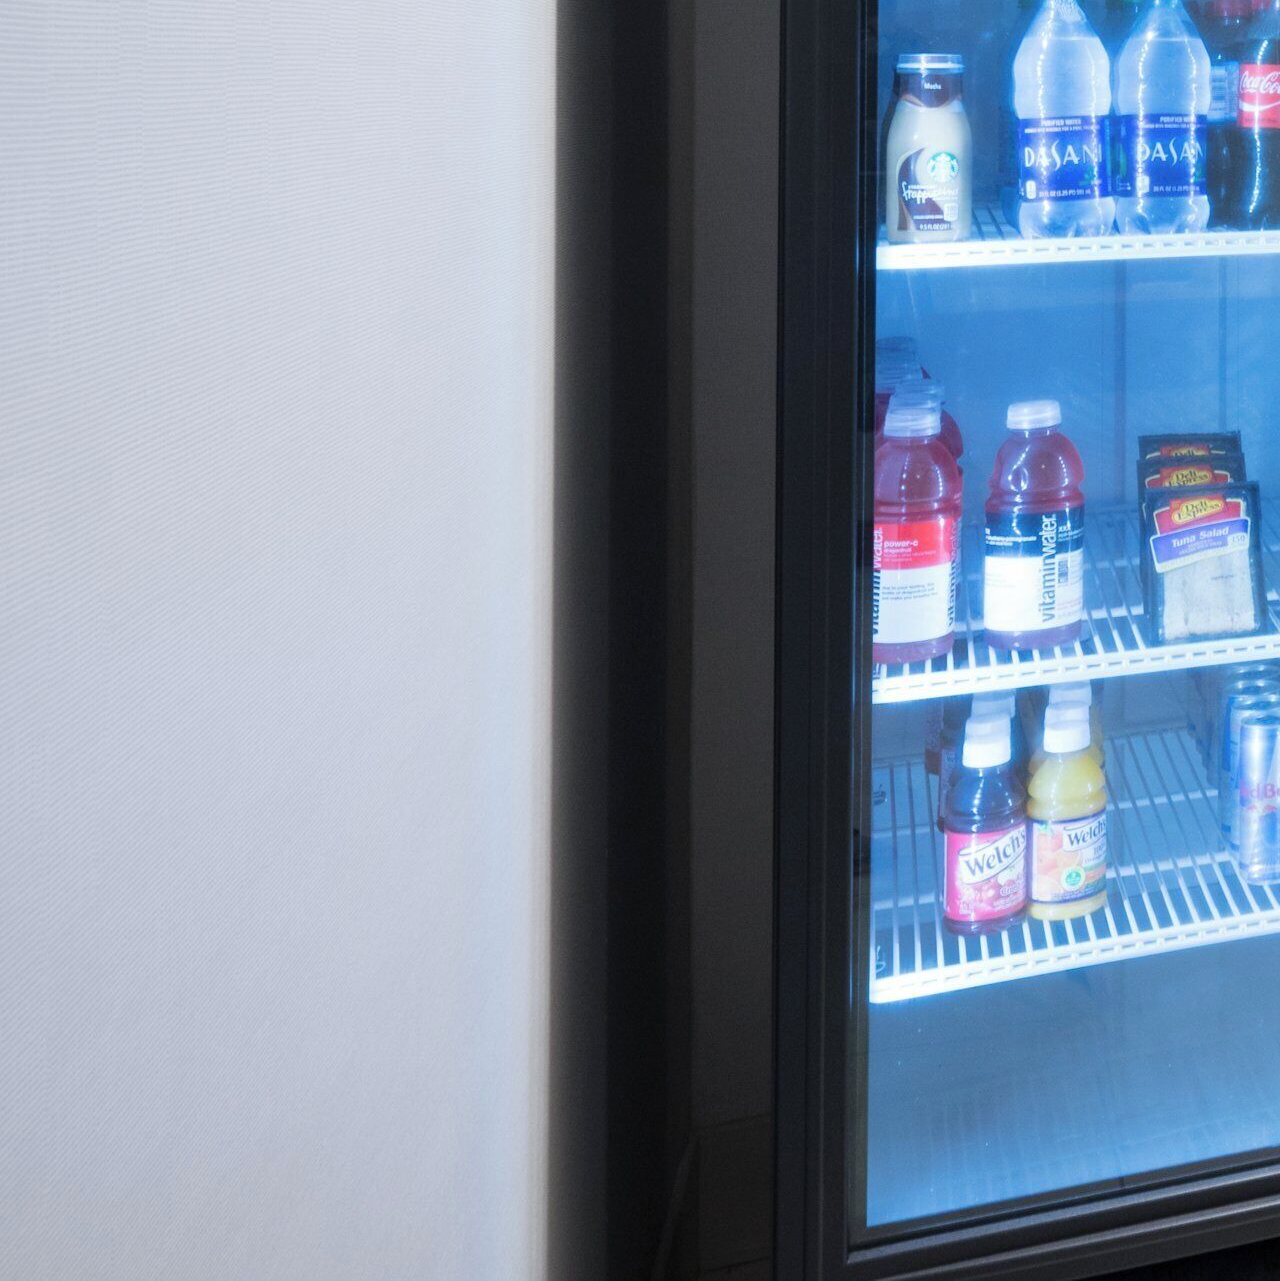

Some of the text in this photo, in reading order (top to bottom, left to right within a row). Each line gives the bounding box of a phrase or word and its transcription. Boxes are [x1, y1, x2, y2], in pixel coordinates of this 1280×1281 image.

[924, 82, 941, 90] Mocha
[1024, 140, 1102, 172] DASANI
[1136, 137, 1203, 166] DASAN
[1175, 470, 1197, 480] Deli
[1177, 502, 1220, 521] Express
[1185, 500, 1208, 513] Deli
[884, 540, 918, 549] power-c
[1172, 534, 1197, 548] Tuna
[1200, 526, 1230, 539] Salad
[1039, 514, 1057, 622] vitaminwater
[964, 828, 1027, 877] Welch's
